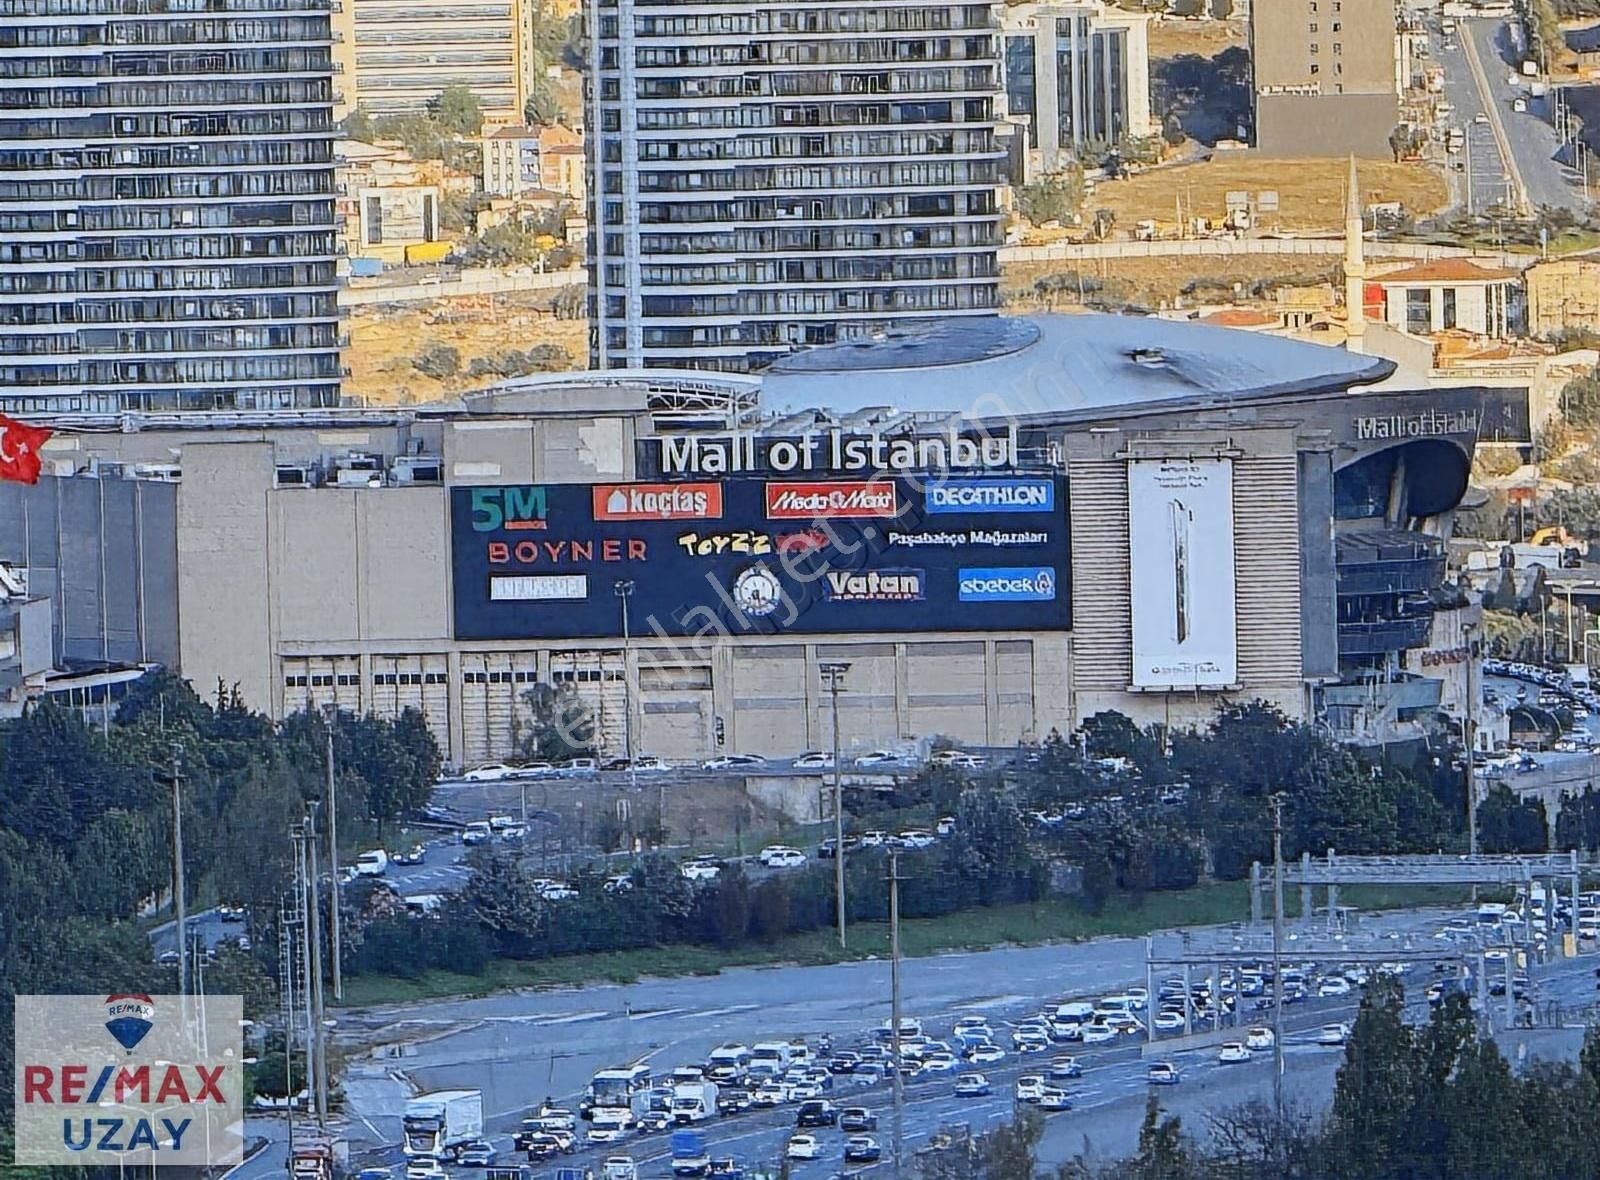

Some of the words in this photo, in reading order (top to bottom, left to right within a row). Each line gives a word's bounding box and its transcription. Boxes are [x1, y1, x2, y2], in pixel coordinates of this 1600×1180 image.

[661, 431, 755, 473] Mall
[769, 431, 819, 472] of
[831, 425, 1018, 471] Istanbul
[630, 487, 708, 518] koçtaş
[931, 484, 1048, 506] DECATHLON
[471, 486, 548, 532] 5M
[888, 531, 966, 548] Paşabahçe
[970, 529, 1048, 547] Mağazaları
[488, 539, 649, 564] BOYNER
[826, 571, 919, 595] Vatan
[960, 577, 1034, 594] ebebek
